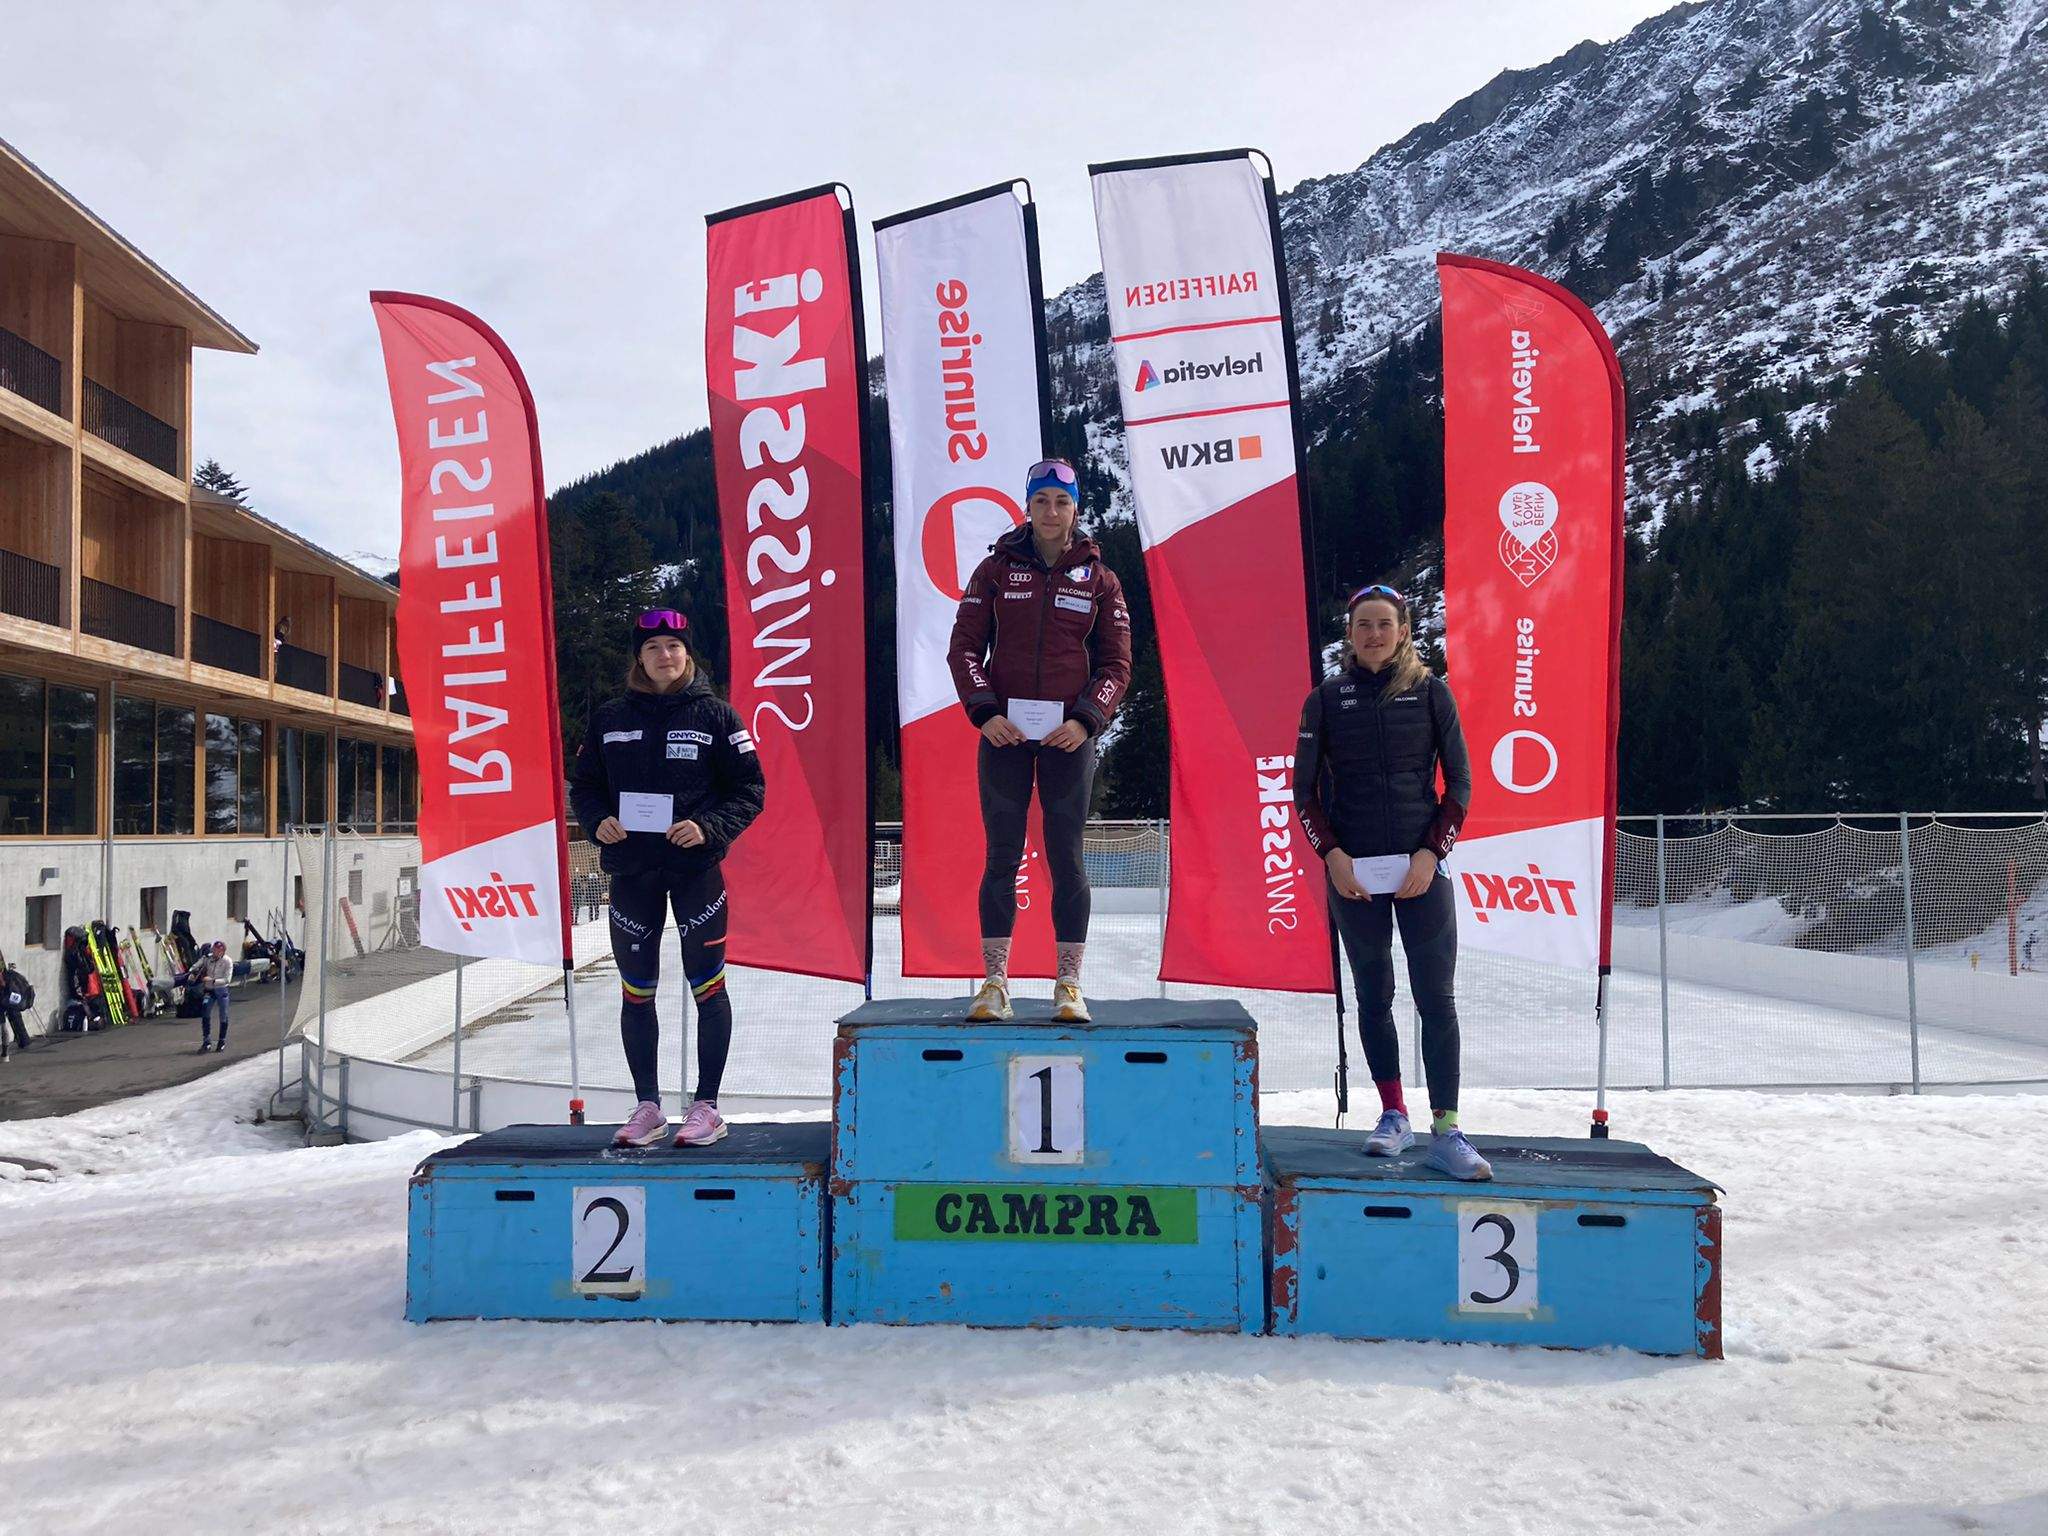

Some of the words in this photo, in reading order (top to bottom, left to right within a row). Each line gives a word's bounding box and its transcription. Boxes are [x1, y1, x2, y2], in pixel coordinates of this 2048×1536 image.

[1058, 587, 1093, 598] FALCONERI
[965, 658, 987, 688] Audi
[1097, 679, 1116, 704] EA7
[1301, 818, 1322, 850] Audi
[1029, 1066, 1062, 1154] 1
[934, 1192, 1162, 1237] CAMPRA
[580, 1196, 635, 1283] 2
[1469, 1213, 1520, 1305] 3
